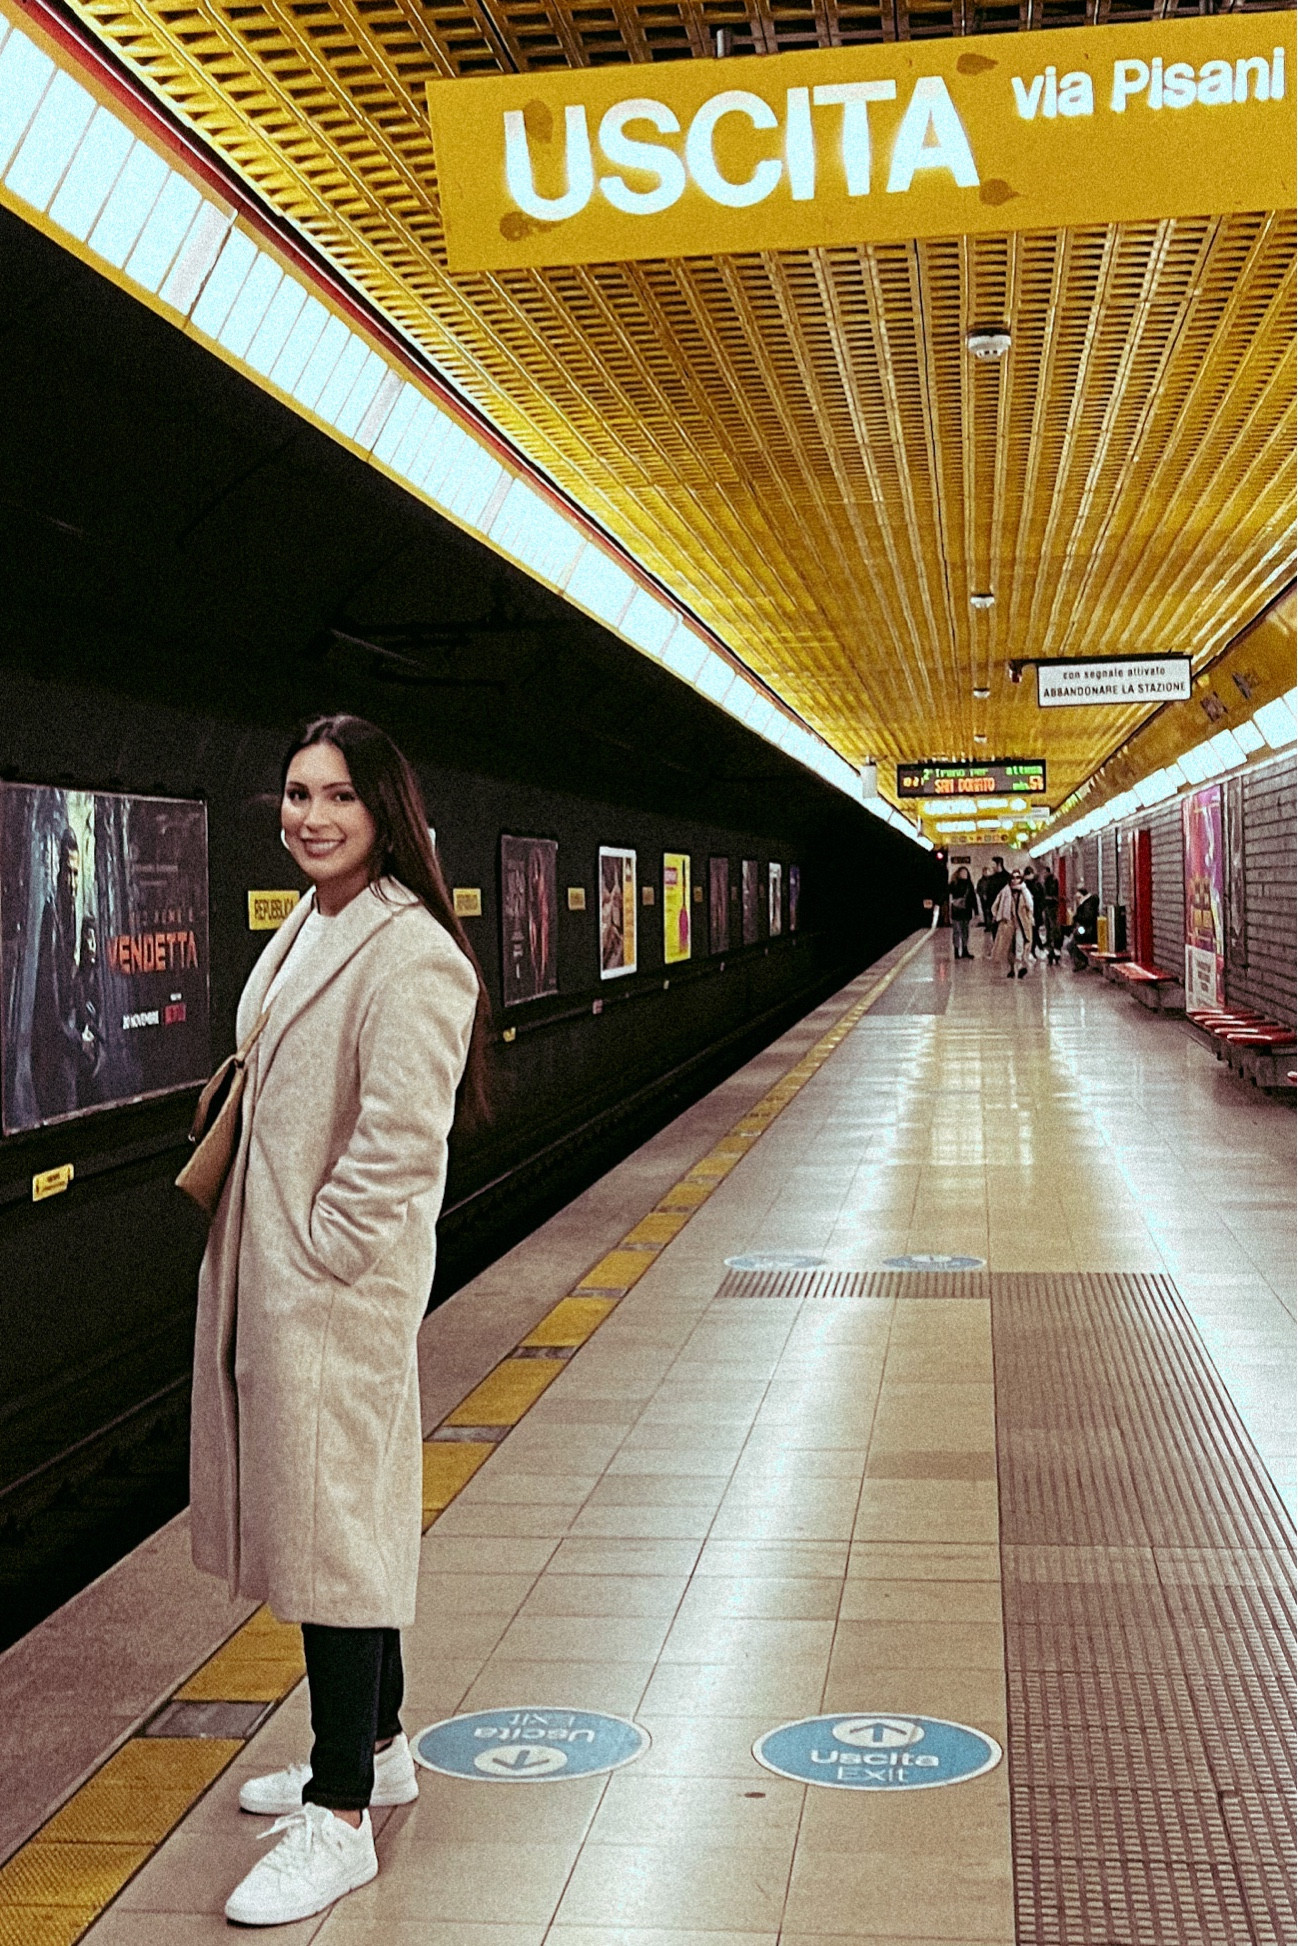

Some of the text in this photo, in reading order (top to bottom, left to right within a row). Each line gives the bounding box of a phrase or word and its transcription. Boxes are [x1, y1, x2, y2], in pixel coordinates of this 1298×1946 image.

[503, 47, 1286, 222] USCITA via Pisani
[1063, 666, 1166, 680] con segnale attivato
[1043, 682, 1186, 698] ABBANDONARE LA STAZIONE
[934, 778, 955, 793] SAN
[958, 777, 996, 792] DONATO
[107, 931, 198, 975] VENDETTA
[474, 1727, 596, 1743] Uscita
[811, 1749, 940, 1767] Uscita
